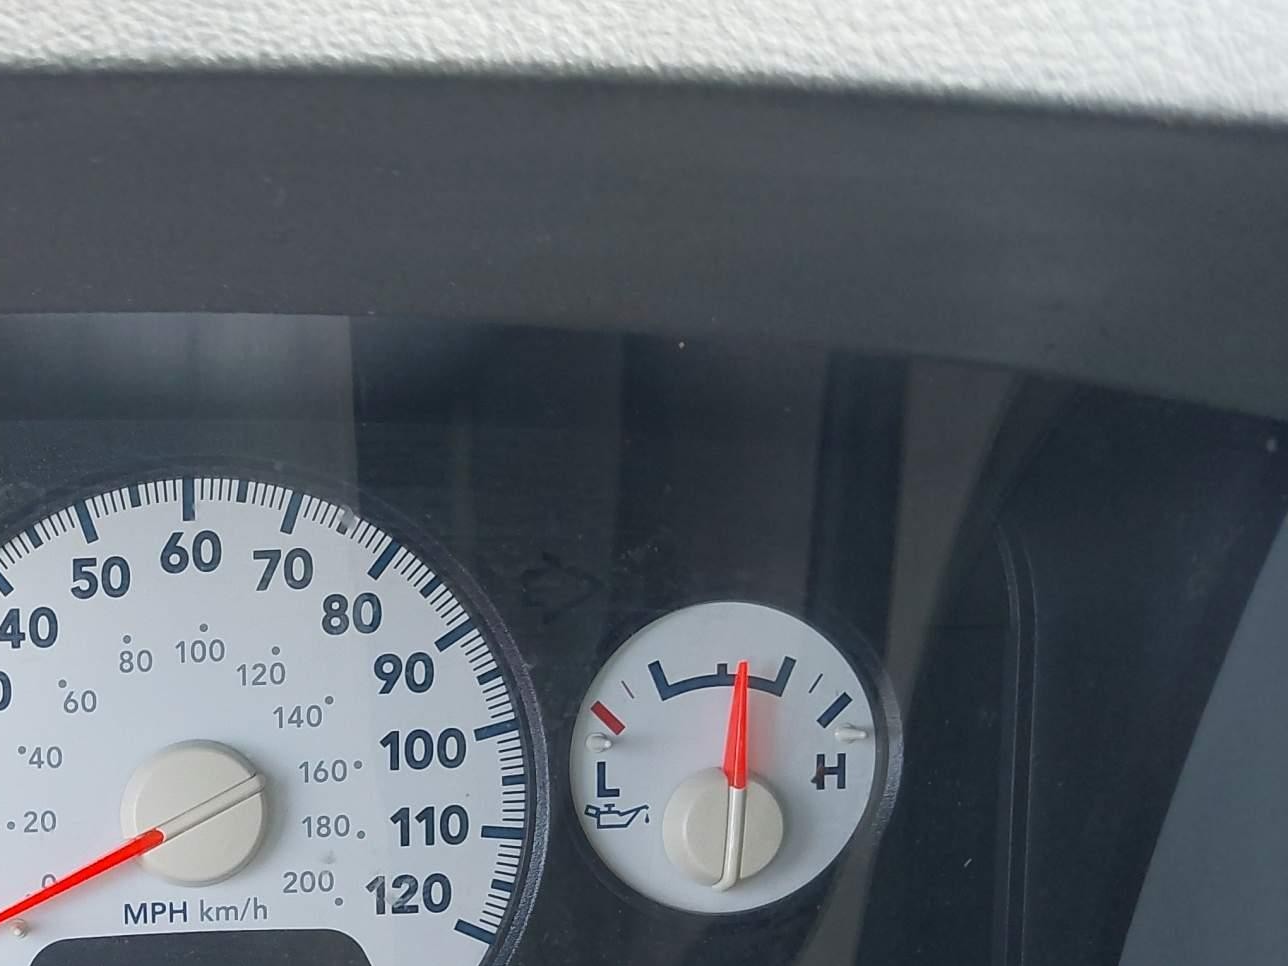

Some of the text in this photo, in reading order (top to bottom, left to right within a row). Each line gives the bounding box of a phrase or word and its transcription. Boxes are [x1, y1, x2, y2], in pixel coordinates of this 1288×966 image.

[160, 530, 221, 573] 60
[71, 556, 130, 599] 50
[253, 548, 313, 591] 70
[322, 593, 382, 635] 80
[120, 650, 152, 673] 80
[176, 639, 225, 663] 100
[237, 663, 285, 686] 120
[374, 652, 434, 694] 90
[63, 690, 96, 713] 60
[273, 705, 322, 728] 140
[29, 747, 62, 768] 40
[380, 728, 466, 770] 100
[299, 760, 347, 783] 160
[597, 762, 620, 797] L
[816, 753, 846, 790] H
[24, 811, 56, 832] 20
[302, 815, 350, 837] 180
[390, 805, 469, 846] 110
[283, 871, 334, 893] 200
[366, 873, 451, 914] 120
[125, 897, 267, 924] MPH km/h
